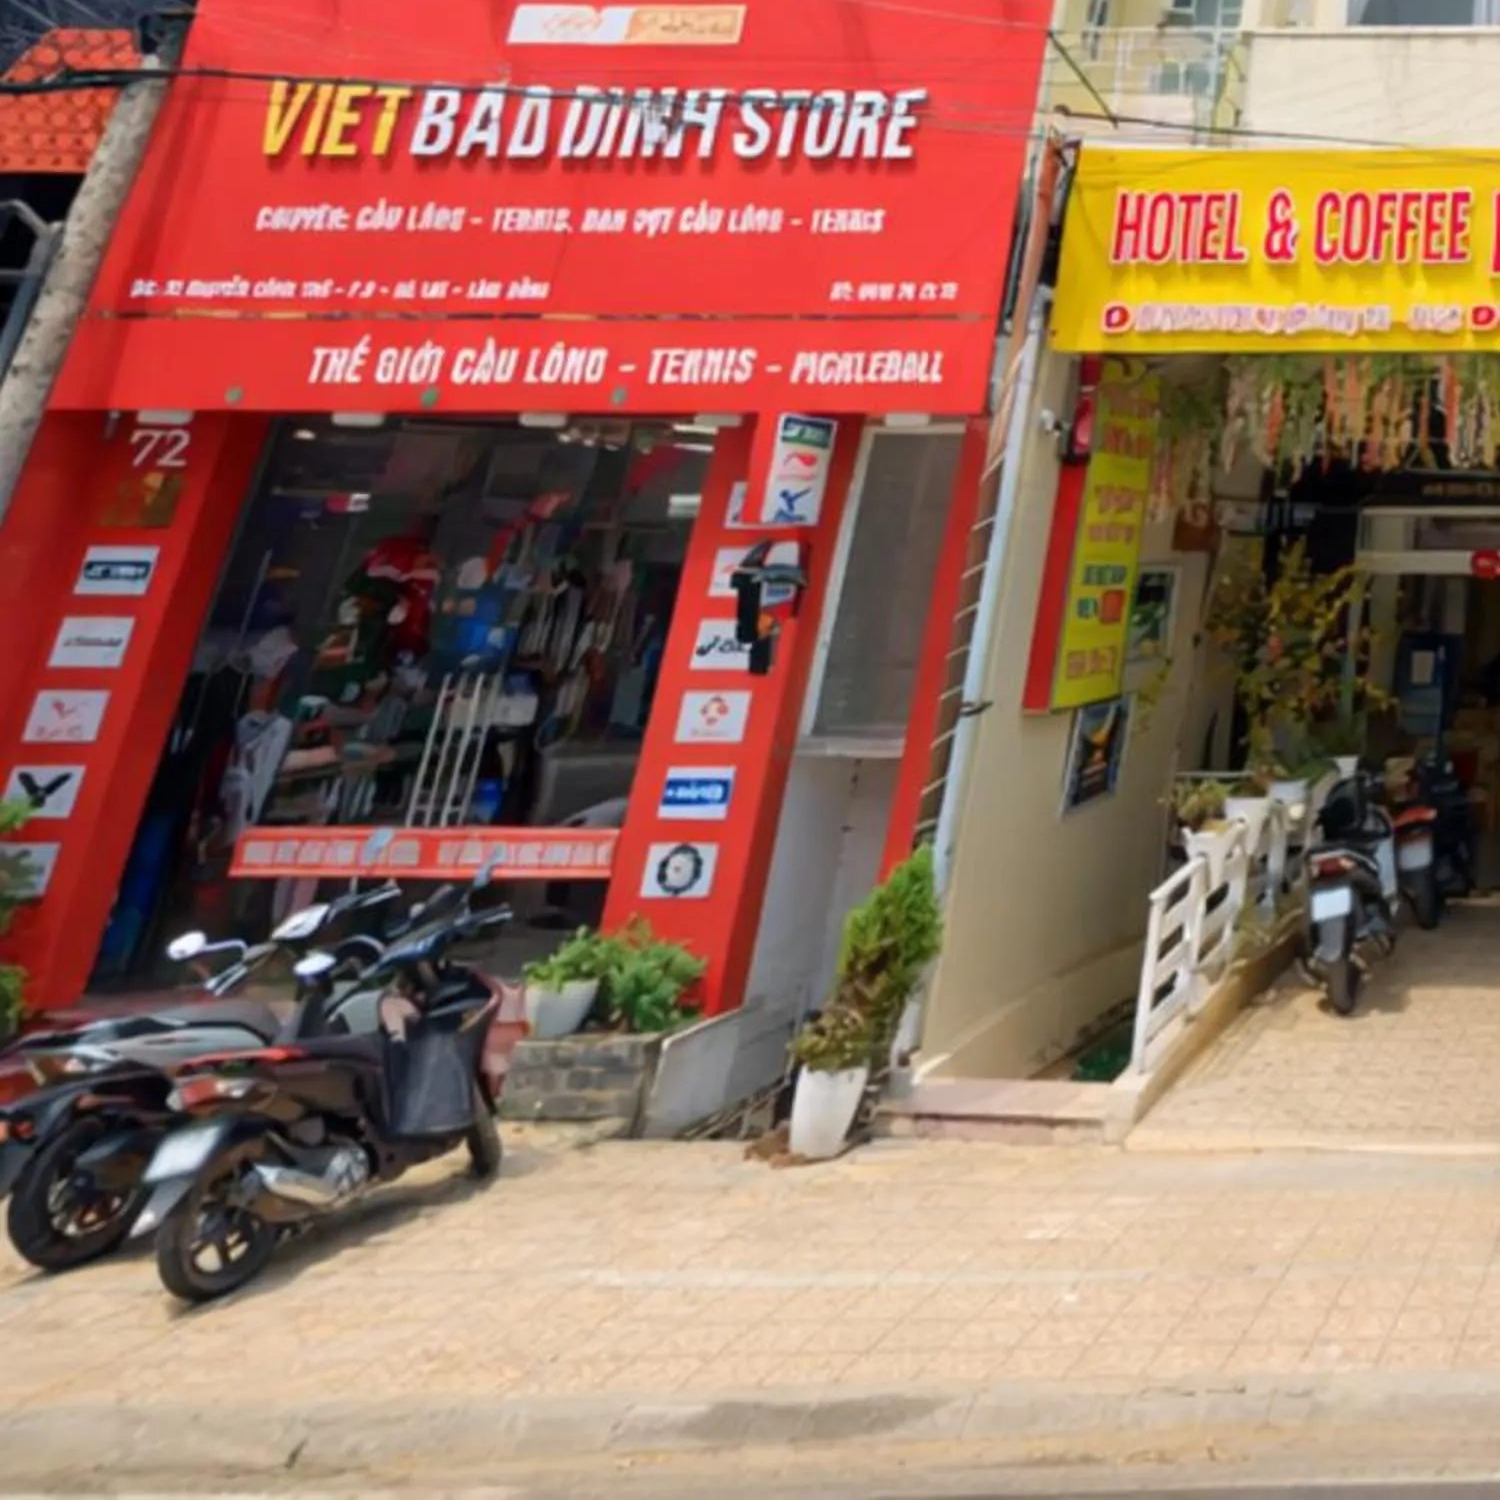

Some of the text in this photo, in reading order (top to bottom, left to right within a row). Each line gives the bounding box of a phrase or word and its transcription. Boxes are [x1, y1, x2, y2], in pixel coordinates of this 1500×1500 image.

[732, 87, 928, 159] STORE
[1111, 190, 1250, 264] HOTEL
[1262, 188, 1299, 264] &
[1313, 189, 1473, 264] COFFEE
[130, 429, 189, 467] 72
